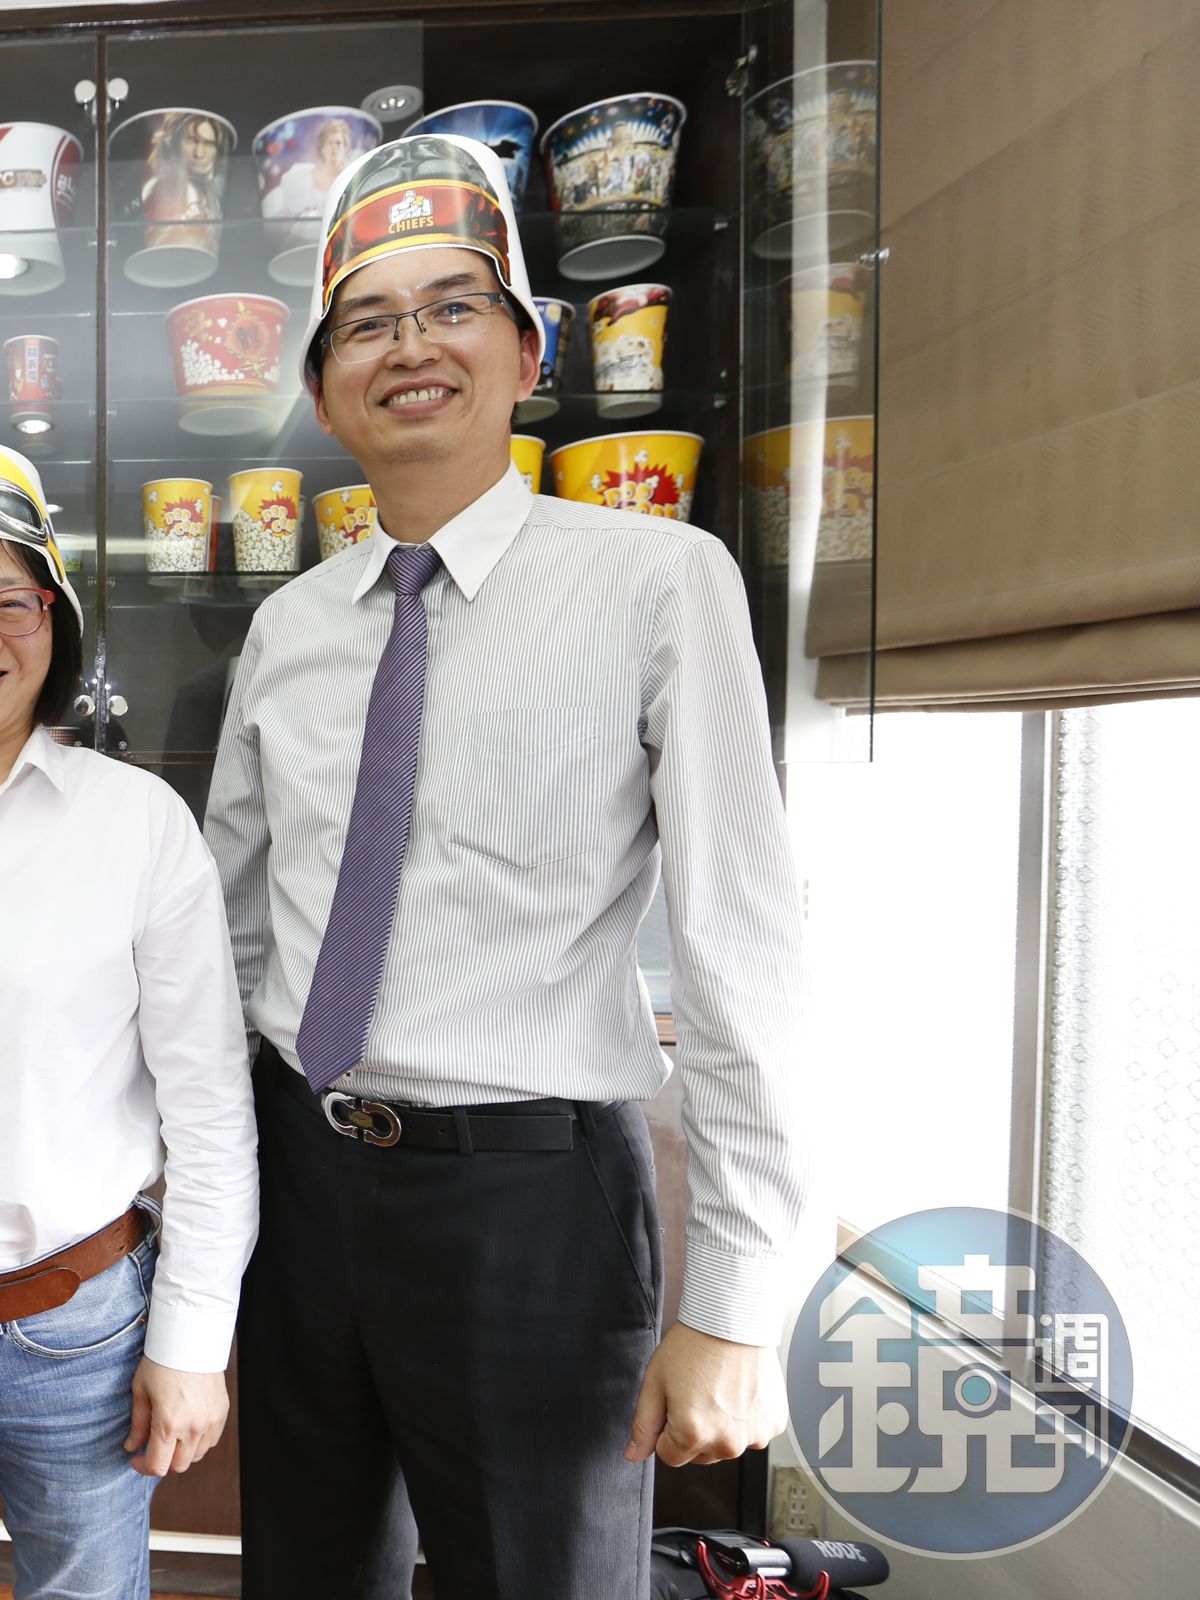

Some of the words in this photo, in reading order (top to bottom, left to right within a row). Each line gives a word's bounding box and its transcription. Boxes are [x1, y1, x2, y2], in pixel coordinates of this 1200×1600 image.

[388, 216, 435, 234] CHIEFS
[603, 479, 655, 508] POP
[164, 507, 192, 525] POP
[261, 504, 288, 522] POP
